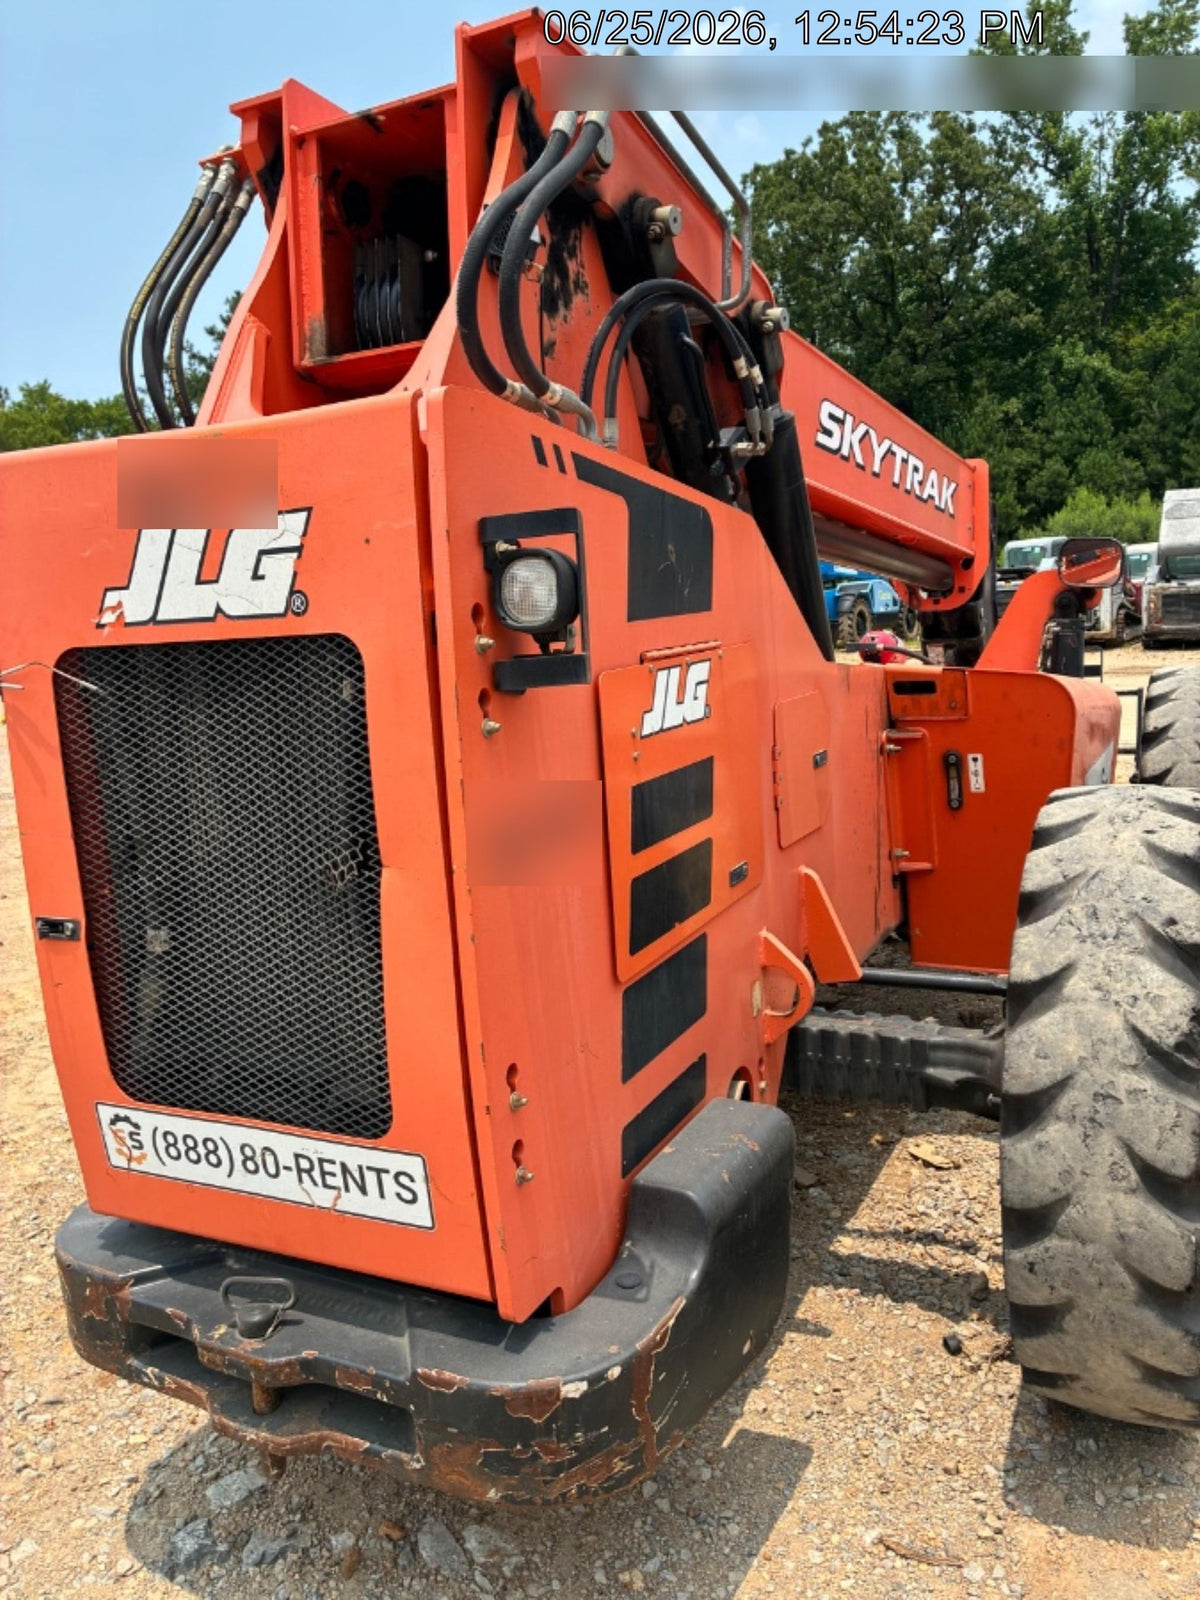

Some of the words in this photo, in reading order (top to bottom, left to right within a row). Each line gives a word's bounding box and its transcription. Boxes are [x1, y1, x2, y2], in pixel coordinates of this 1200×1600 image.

[814, 397, 959, 519] SKYTRAK
[96, 506, 313, 630] JLG
[640, 658, 711, 740] JLG
